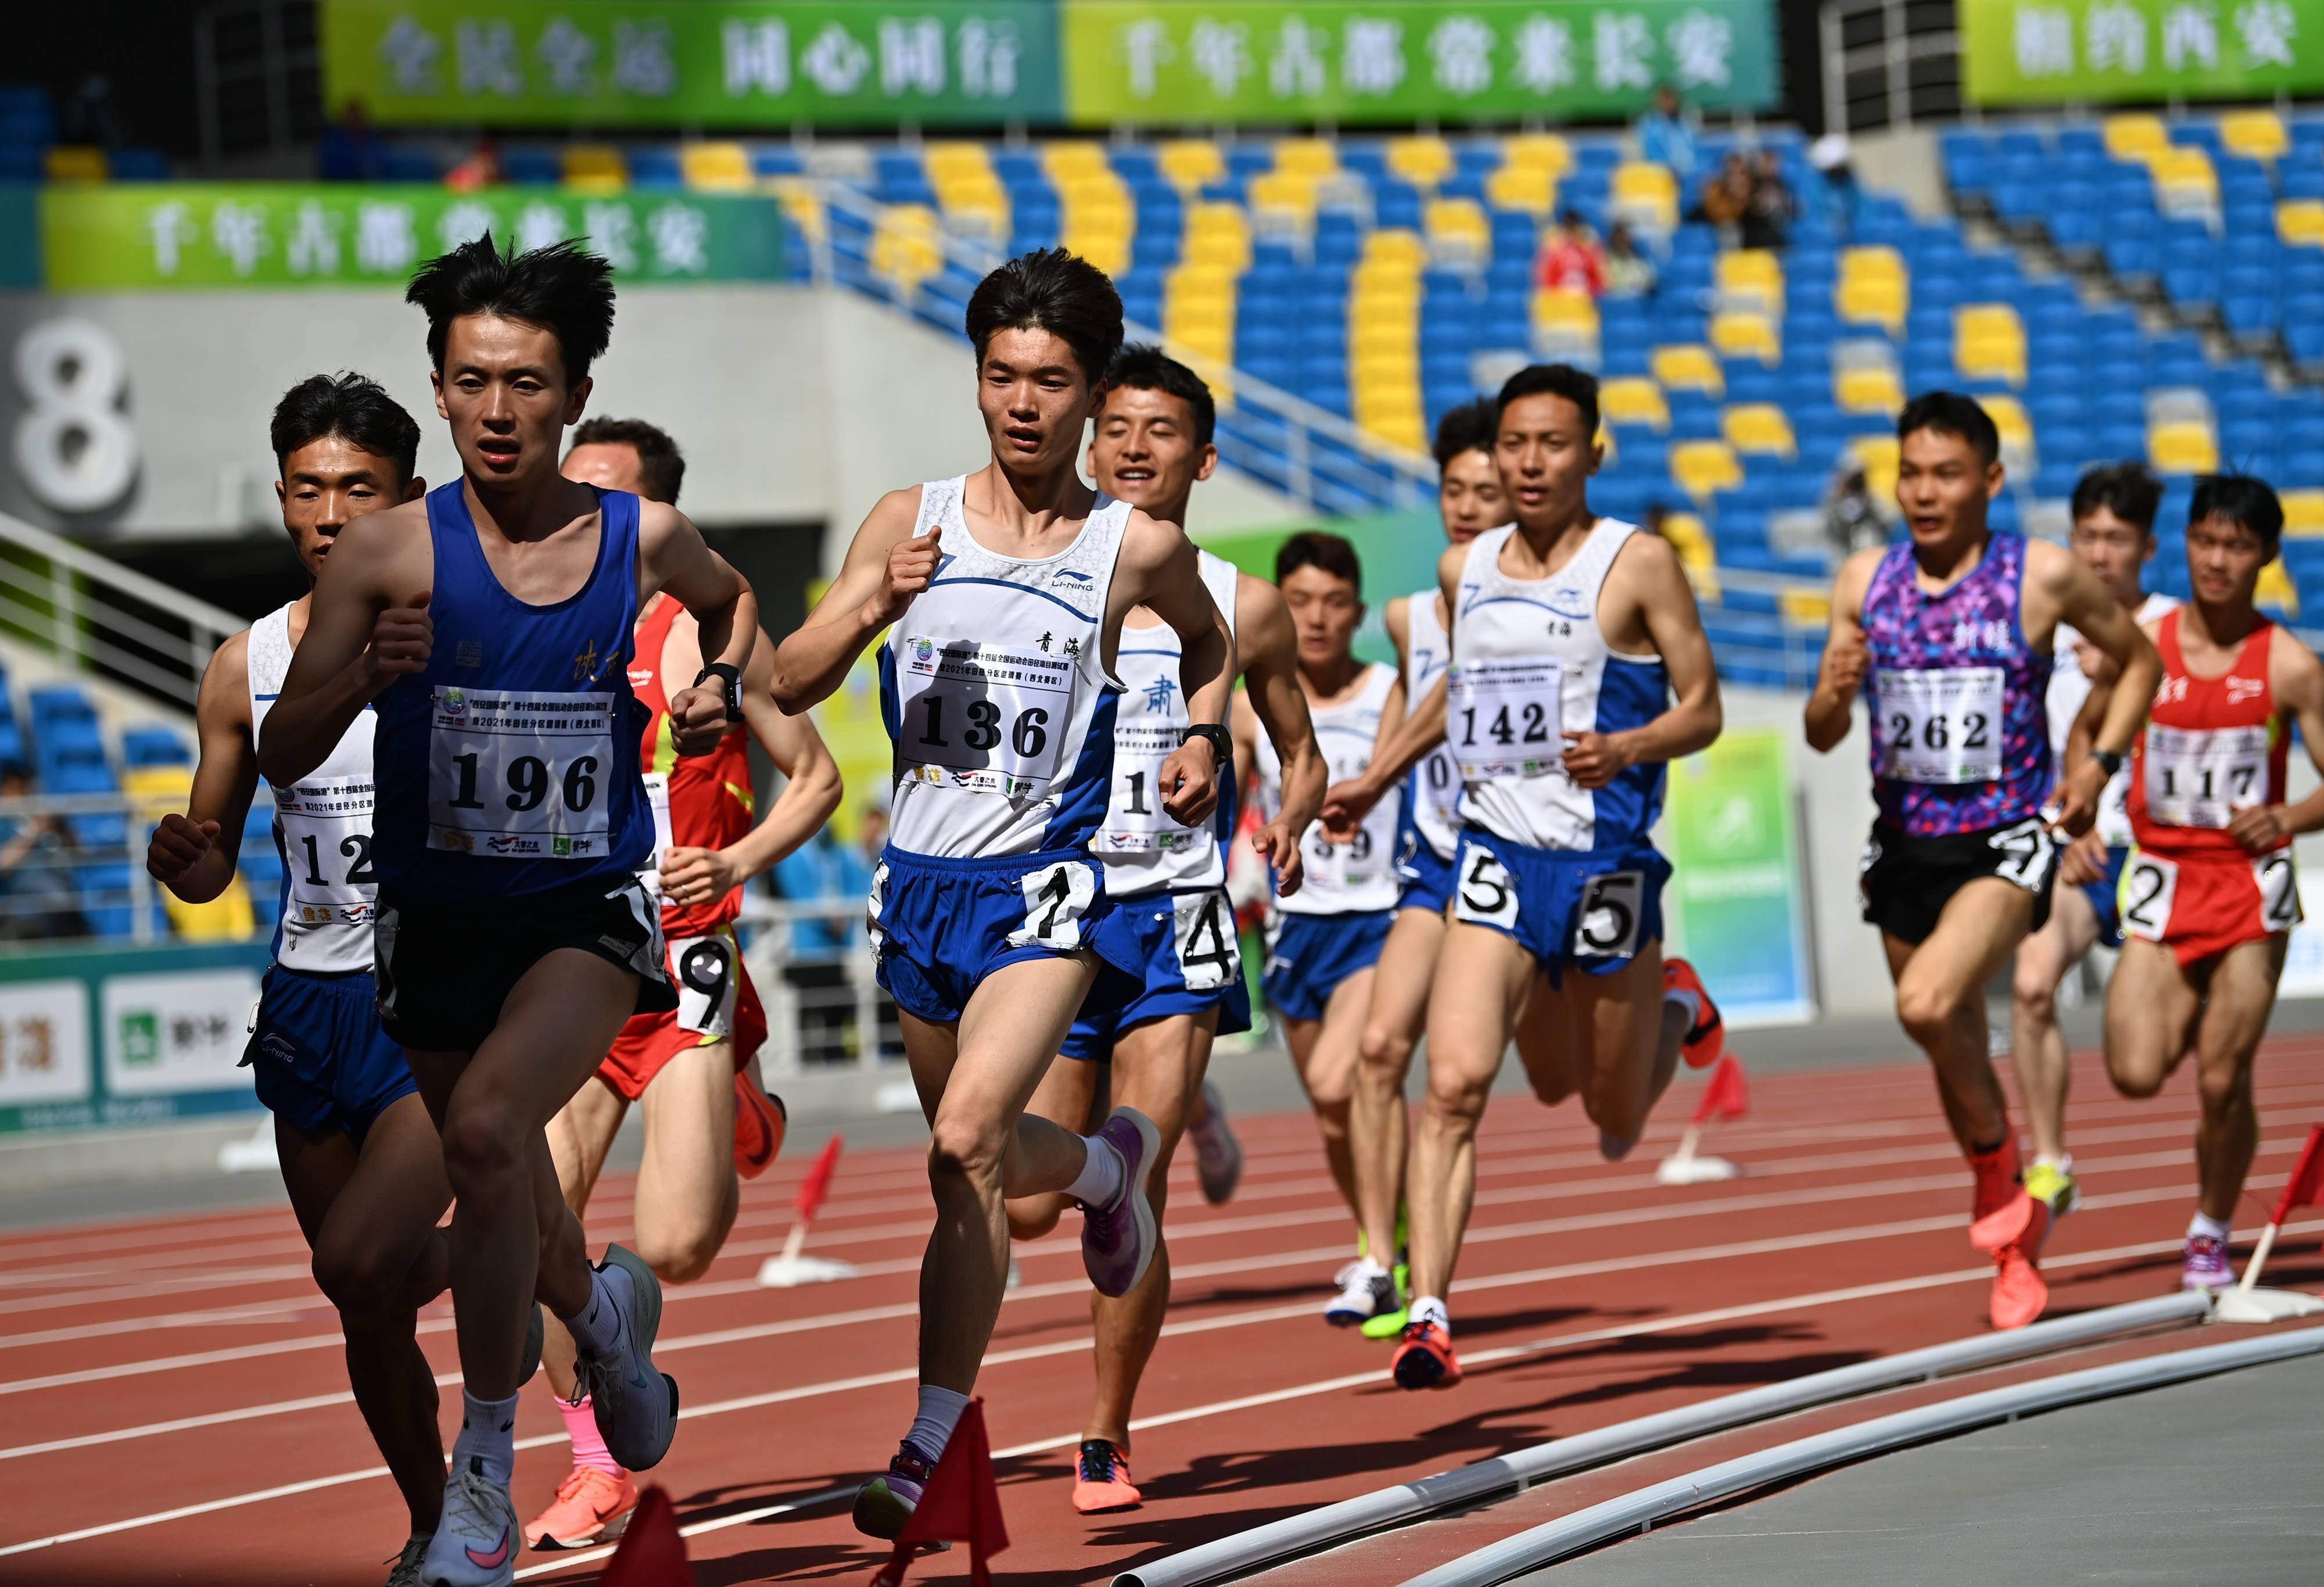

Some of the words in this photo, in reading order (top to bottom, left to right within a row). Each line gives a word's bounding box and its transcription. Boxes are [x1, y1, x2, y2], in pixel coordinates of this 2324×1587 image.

[721, 16, 1018, 98] 同心同行
[1116, 14, 1405, 100] 千年古都
[1426, 8, 1733, 96] 常来长安
[2014, 1, 2296, 78] 相约西安
[148, 200, 417, 277] 千年古都
[13, 318, 135, 510] 8
[1052, 581, 1093, 591] LI-NING
[1036, 631, 1079, 655] 青海
[919, 696, 1048, 758] 136
[1462, 703, 1547, 746] 142
[1892, 713, 1988, 750] 262
[449, 753, 598, 812] 196
[1124, 772, 1152, 815] 1
[2162, 766, 2258, 800] 117
[302, 834, 376, 886] 12
[1463, 857, 1507, 912] 5
[2265, 858, 2294, 919] 2
[1582, 877, 1636, 949] 5
[2129, 865, 2162, 926] 2
[1183, 895, 1236, 979] 4
[679, 940, 730, 1028] 9
[261, 1043, 294, 1062] LI-NING
